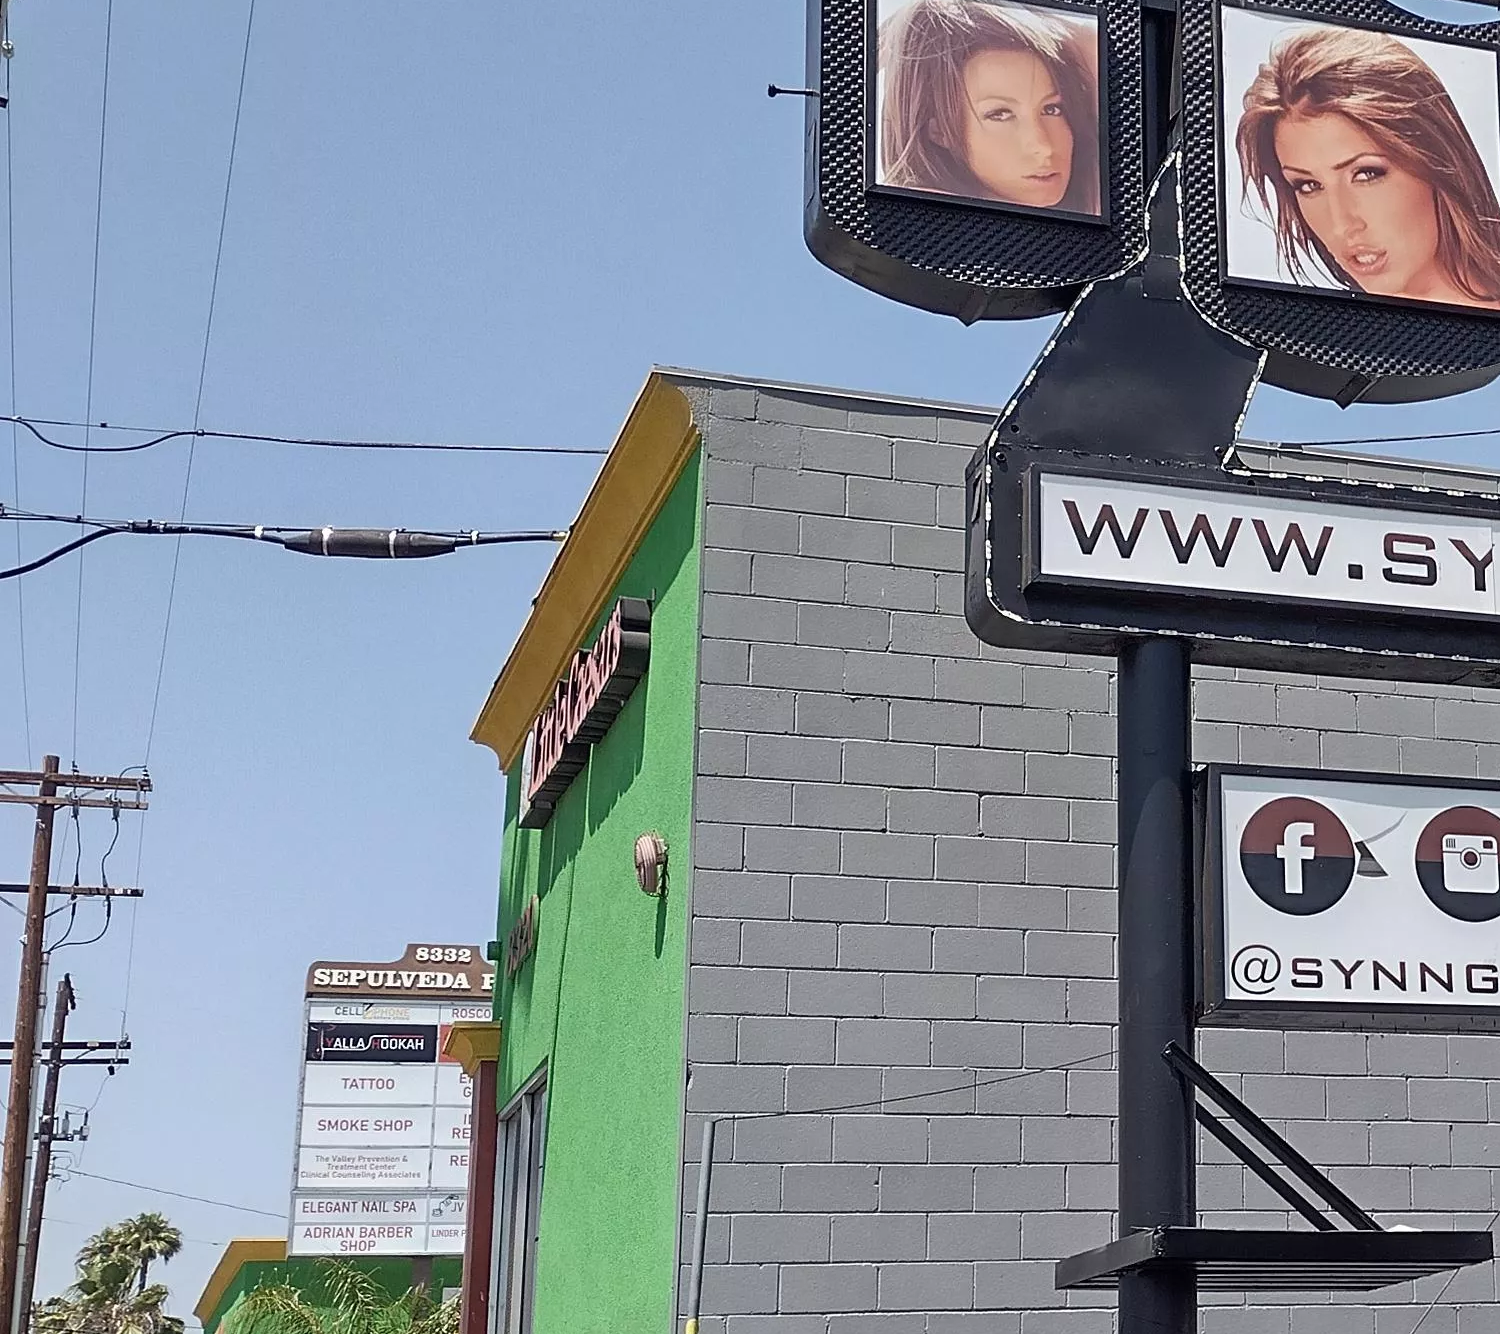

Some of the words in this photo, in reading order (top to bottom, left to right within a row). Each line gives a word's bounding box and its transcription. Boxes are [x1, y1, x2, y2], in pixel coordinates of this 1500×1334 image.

[415, 947, 472, 963] 8332
[313, 968, 472, 990] SEPULVEDA
[334, 1006, 362, 1017] CELL
[325, 1037, 366, 1049] YALLA
[372, 1038, 425, 1050] HOOKAH
[342, 1077, 395, 1090] TATTOO
[317, 1119, 369, 1132] SMOKE
[373, 1119, 413, 1132] SHOP
[332, 1155, 356, 1164] Valley
[358, 1155, 400, 1163] Prevention
[331, 1171, 376, 1180] Counseling
[302, 1201, 358, 1214] ELEGANT
[361, 1201, 389, 1213] NAIL
[393, 1201, 417, 1213] SPA
[303, 1226, 355, 1239] ADRIAN
[359, 1226, 413, 1239] BARBER
[431, 1229, 460, 1238] LINDER
[340, 1240, 376, 1251] SHOP
